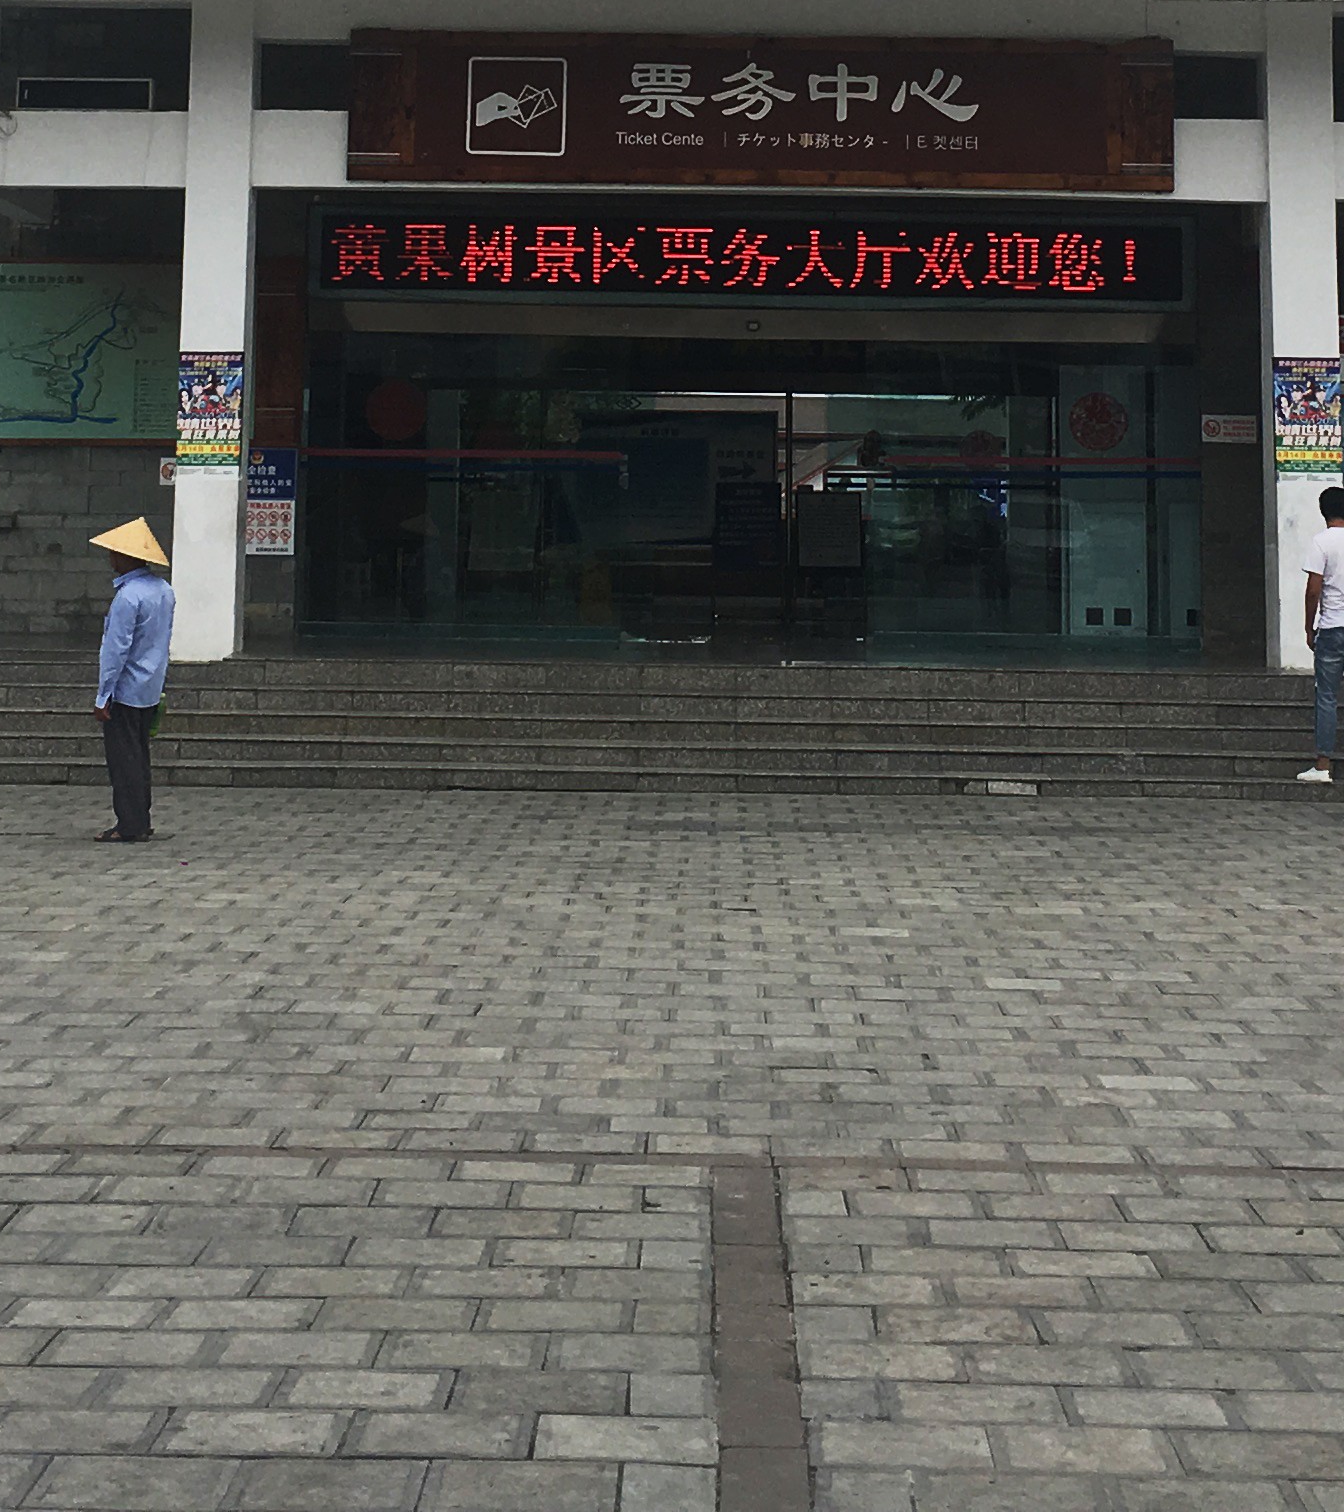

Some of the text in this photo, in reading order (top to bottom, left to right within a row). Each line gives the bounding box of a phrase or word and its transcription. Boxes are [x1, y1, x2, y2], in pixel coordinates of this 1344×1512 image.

[619, 63, 980, 123] 票务中心
[616, 131, 704, 147] Ticket Cente
